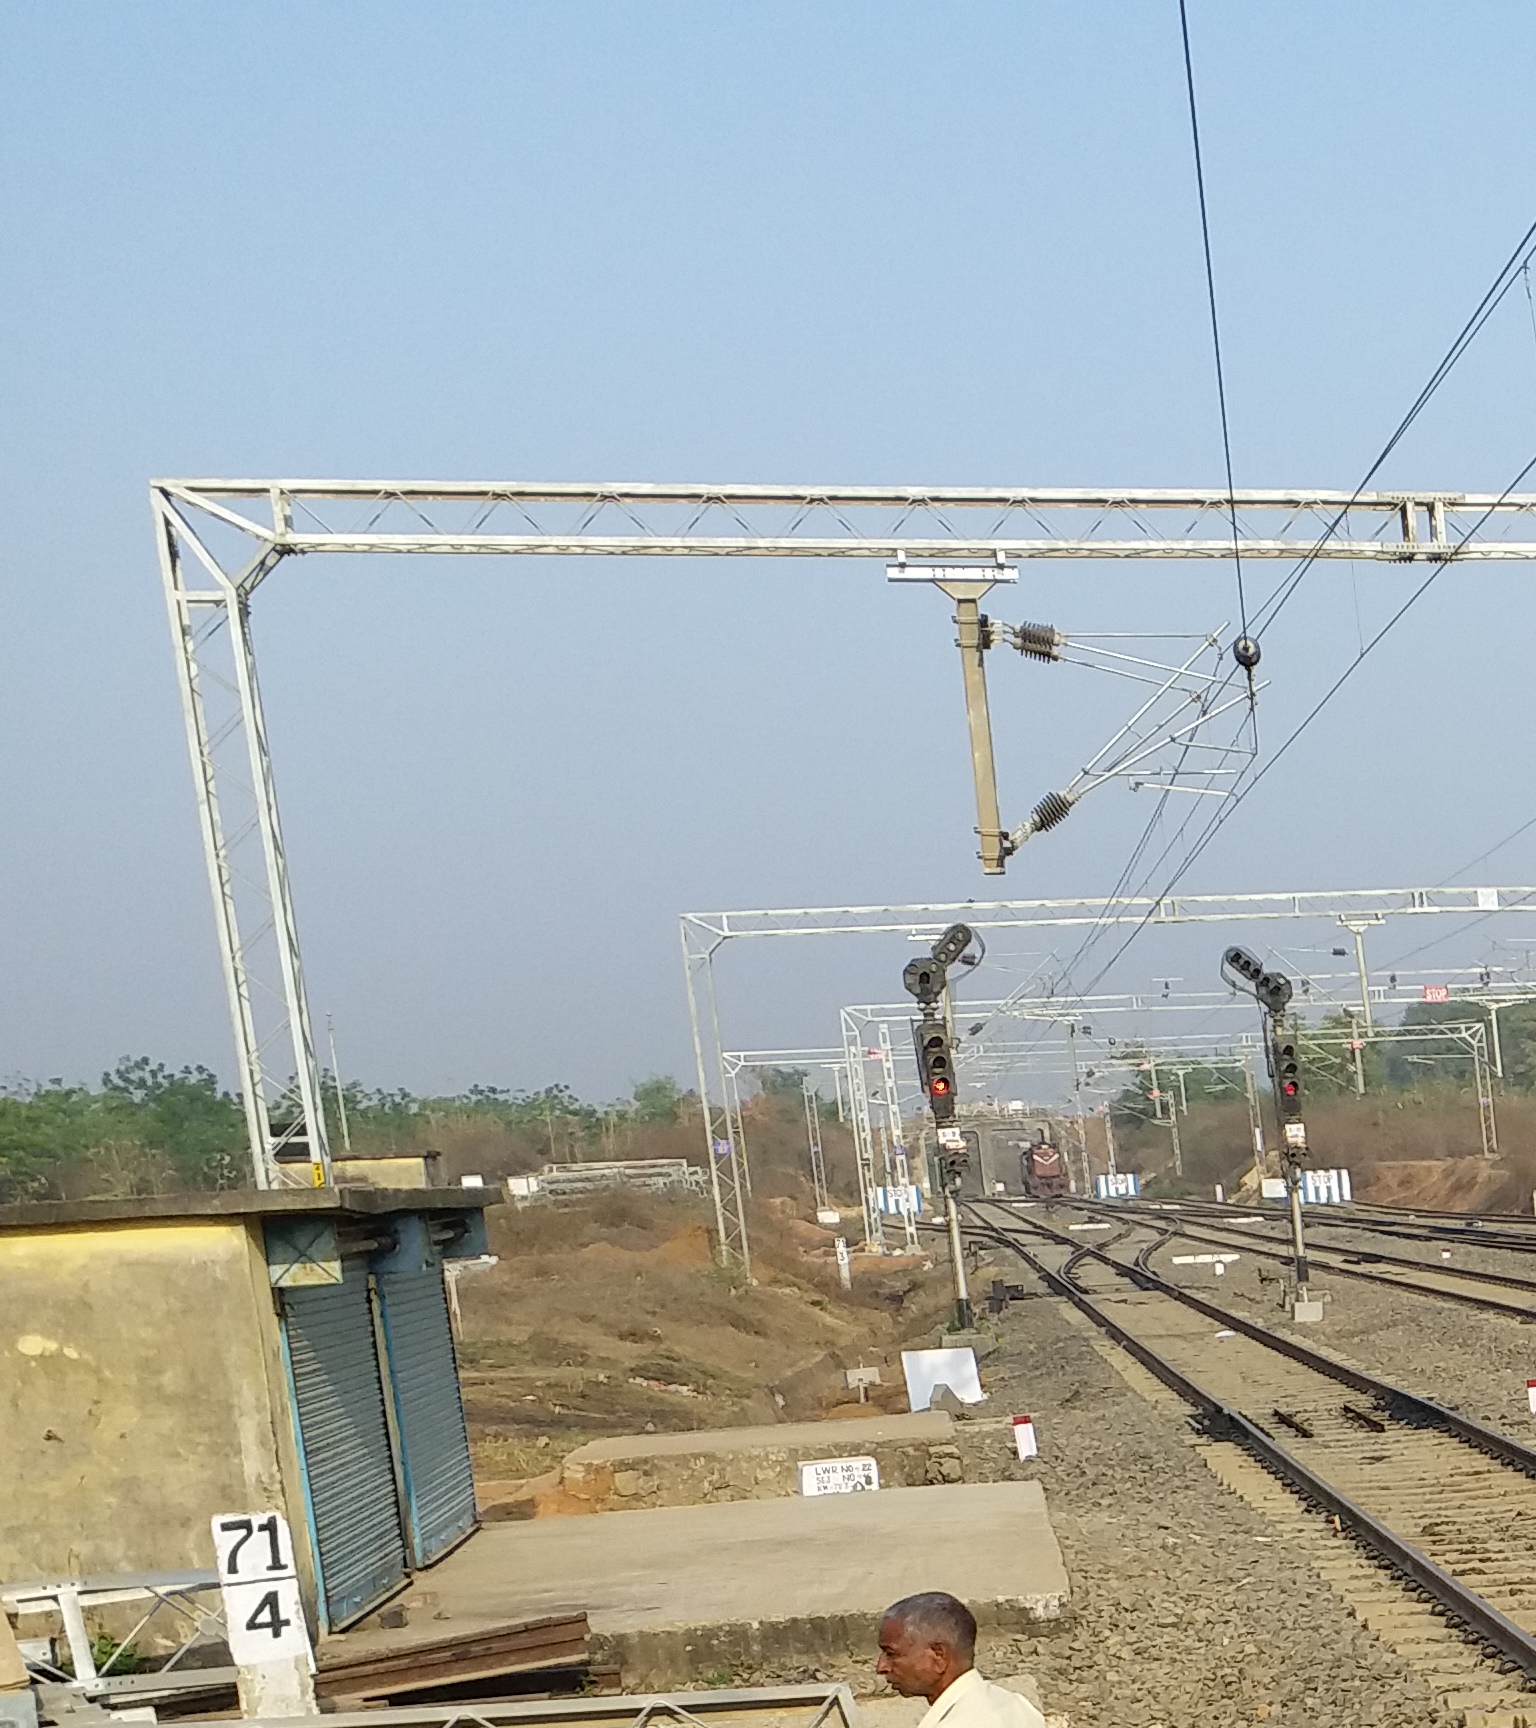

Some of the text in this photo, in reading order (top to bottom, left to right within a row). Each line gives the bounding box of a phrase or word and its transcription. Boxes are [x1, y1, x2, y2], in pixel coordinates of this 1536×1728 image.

[1425, 988, 1448, 1001] STOP
[1311, 1174, 1333, 1185] STOP
[839, 1252, 846, 1262] 3
[815, 1465, 838, 1476] LWR
[220, 1515, 289, 1575] 71
[245, 1590, 291, 1639] 4
